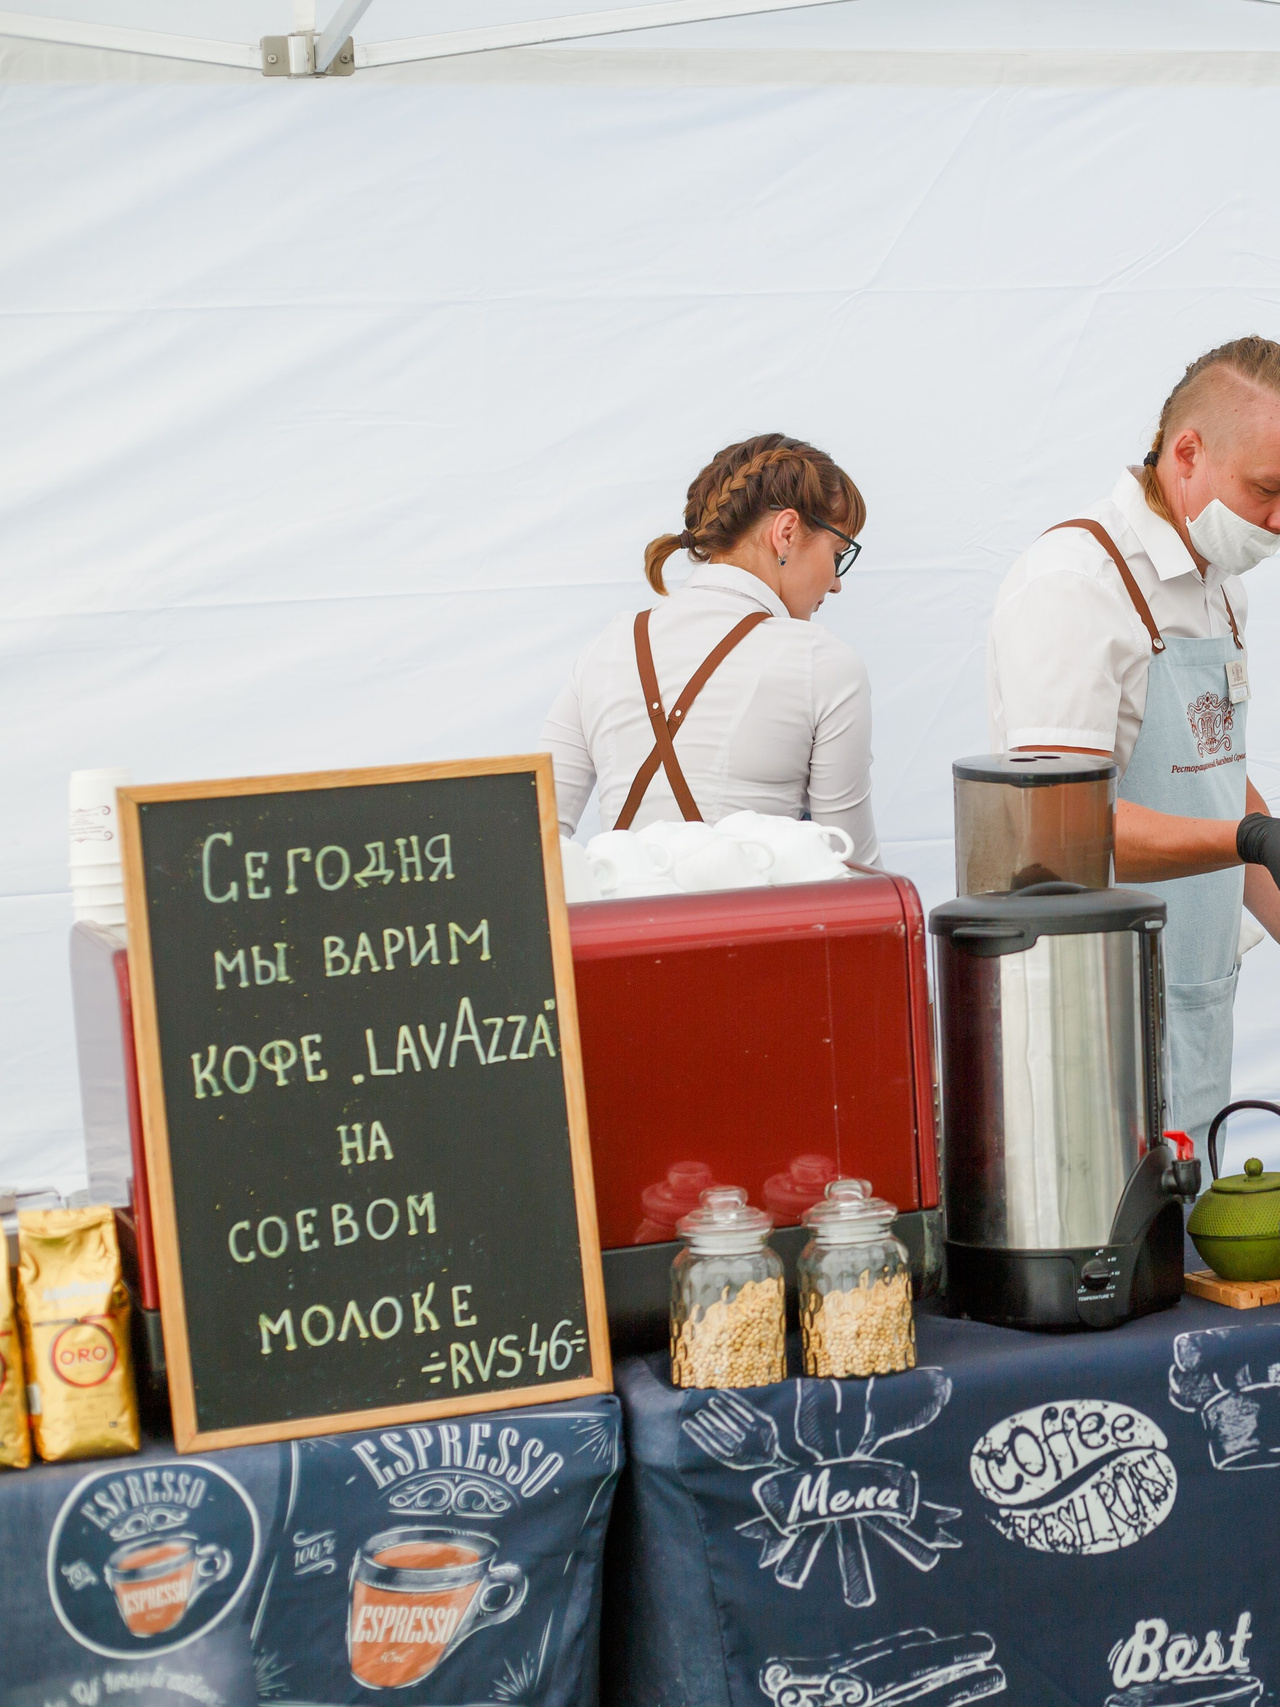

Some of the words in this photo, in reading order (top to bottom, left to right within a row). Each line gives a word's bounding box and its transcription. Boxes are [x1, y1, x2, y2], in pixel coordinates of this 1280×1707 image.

[214, 941, 293, 991] МЫ
[322, 918, 493, 979] ВАРИМ
[191, 1033, 328, 1100] КОФЕ
[336, 1120, 395, 1167] НА
[227, 1191, 438, 1264] СОЕВОМ
[258, 1281, 478, 1355] МОЛОКЕ
[60, 1346, 107, 1366] ORO
[352, 1422, 565, 1499] ESPRESSO
[80, 1470, 207, 1532] ESPRESSO
[121, 1579, 189, 1617] ESPRESSO
[351, 1605, 460, 1644] ESPRESSO
[1112, 1611, 1253, 1689] Best
